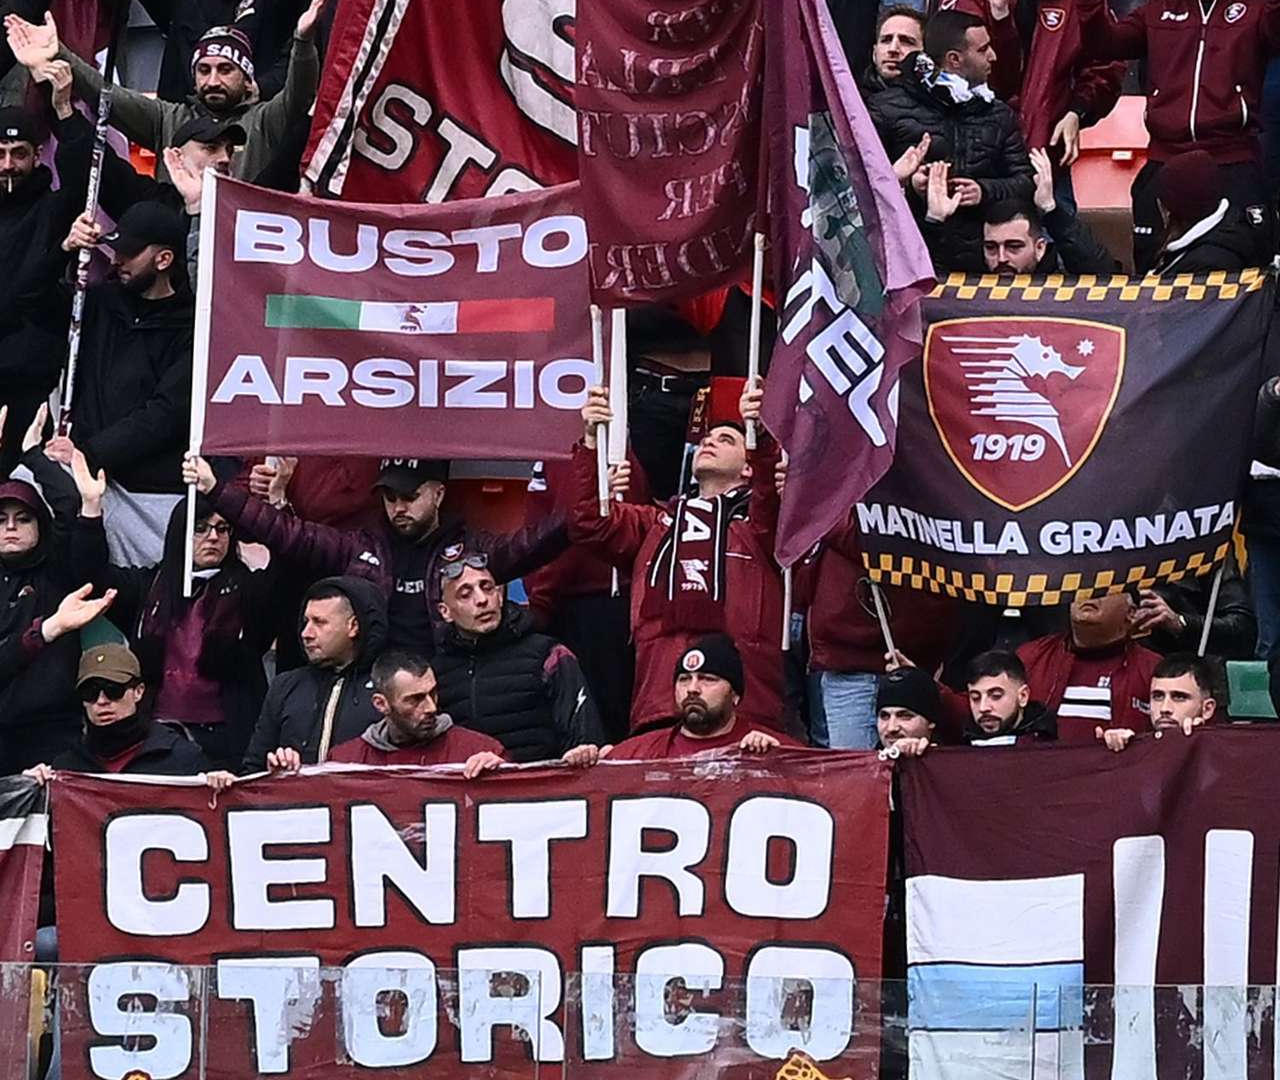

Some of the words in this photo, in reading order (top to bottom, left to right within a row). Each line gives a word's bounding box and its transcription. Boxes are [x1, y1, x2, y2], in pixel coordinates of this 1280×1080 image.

[233, 208, 588, 278] BUSTO
[211, 353, 596, 410] ARSIZIO
[969, 432, 1046, 462] 1919
[855, 501, 1029, 555] MATINELLA
[1040, 500, 1237, 555] GRANATA
[104, 794, 834, 937] CENTRO
[86, 941, 857, 1080] STORICO
